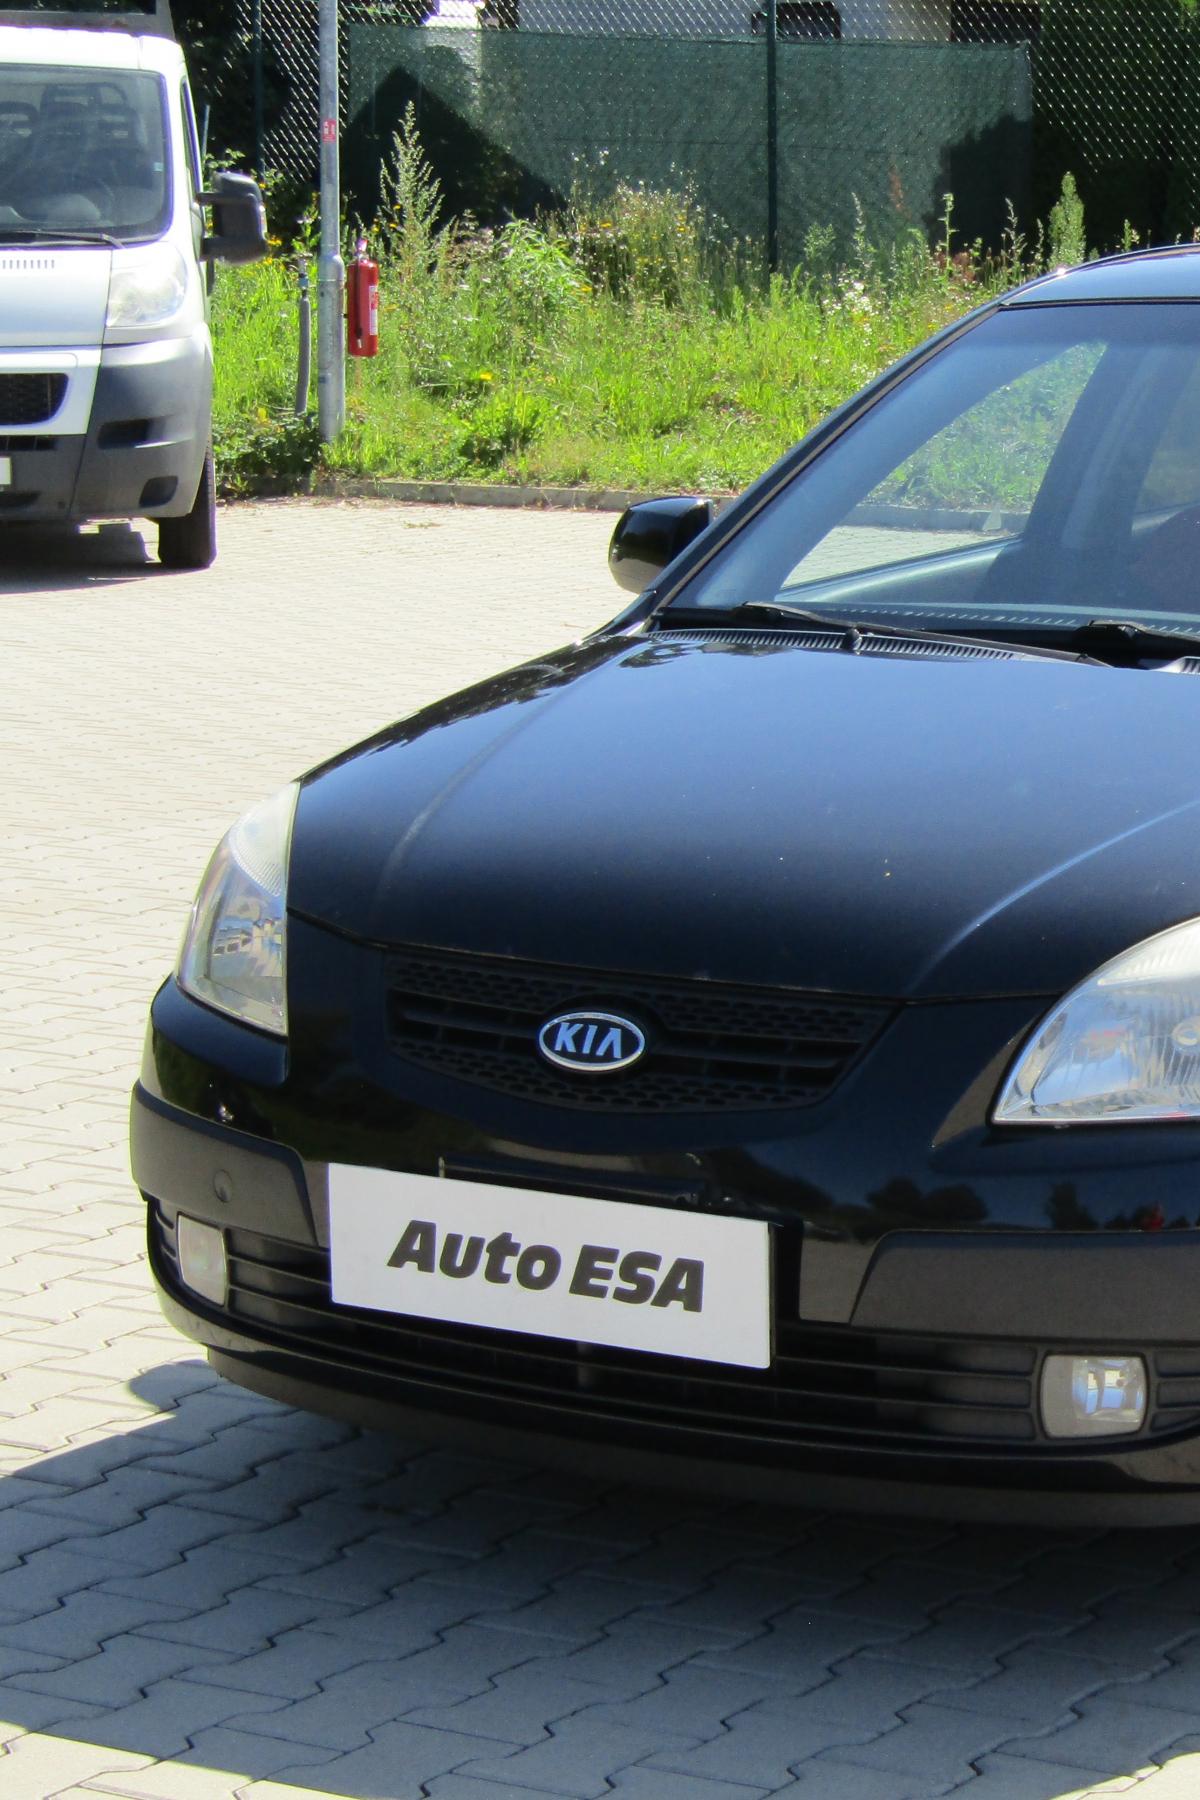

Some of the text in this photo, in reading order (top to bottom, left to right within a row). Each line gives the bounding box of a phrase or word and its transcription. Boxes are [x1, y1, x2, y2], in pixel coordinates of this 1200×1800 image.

[554, 1021, 622, 1059] KIA
[387, 1219, 705, 1312] Auto ESA
